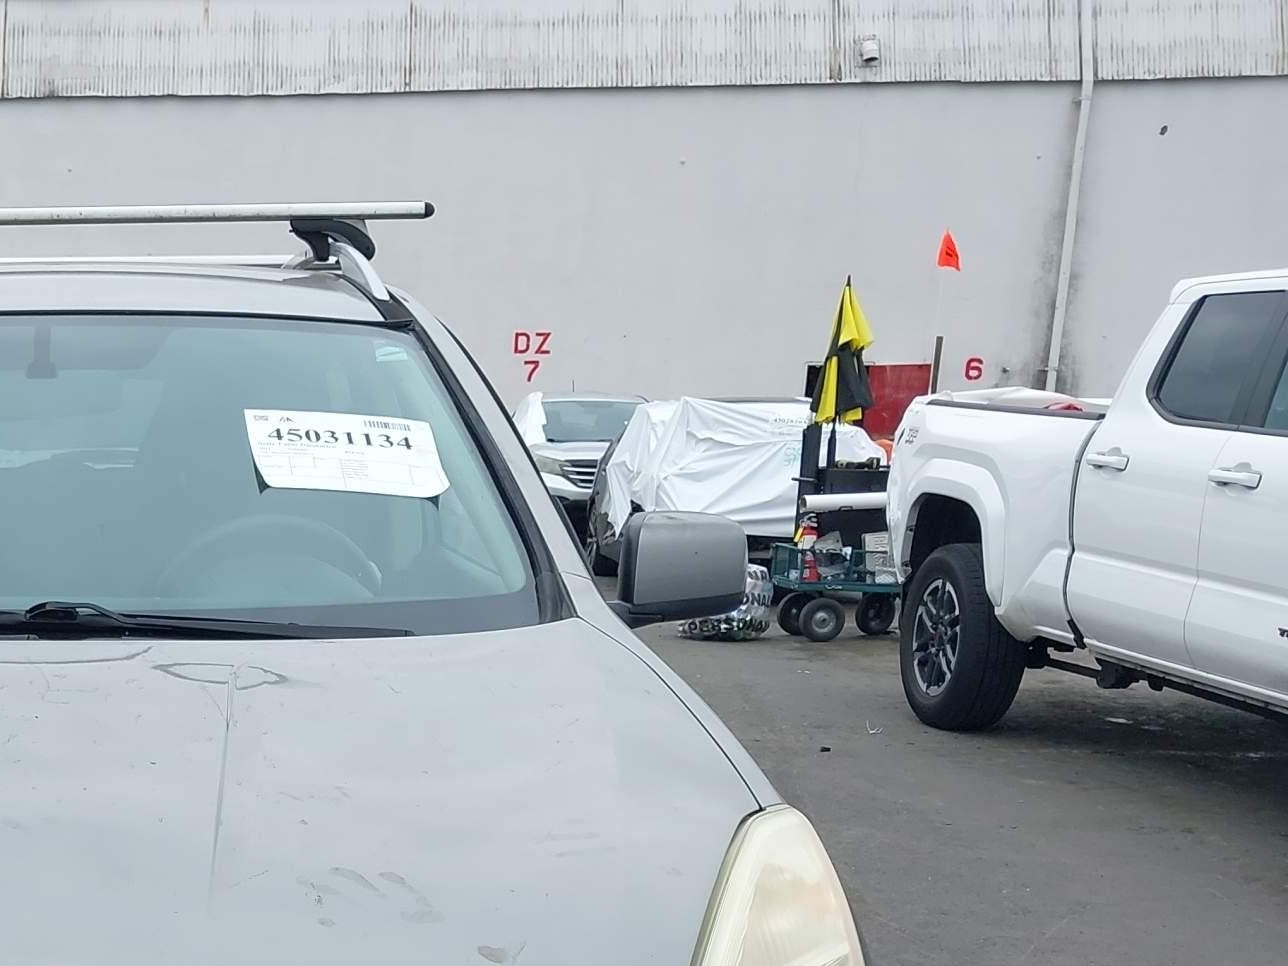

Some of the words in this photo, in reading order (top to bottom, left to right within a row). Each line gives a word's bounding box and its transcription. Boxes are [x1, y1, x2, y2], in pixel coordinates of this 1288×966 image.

[514, 332, 552, 354] DZ
[524, 360, 540, 382] 7
[965, 358, 984, 380] 6
[267, 427, 413, 450] 45031134
